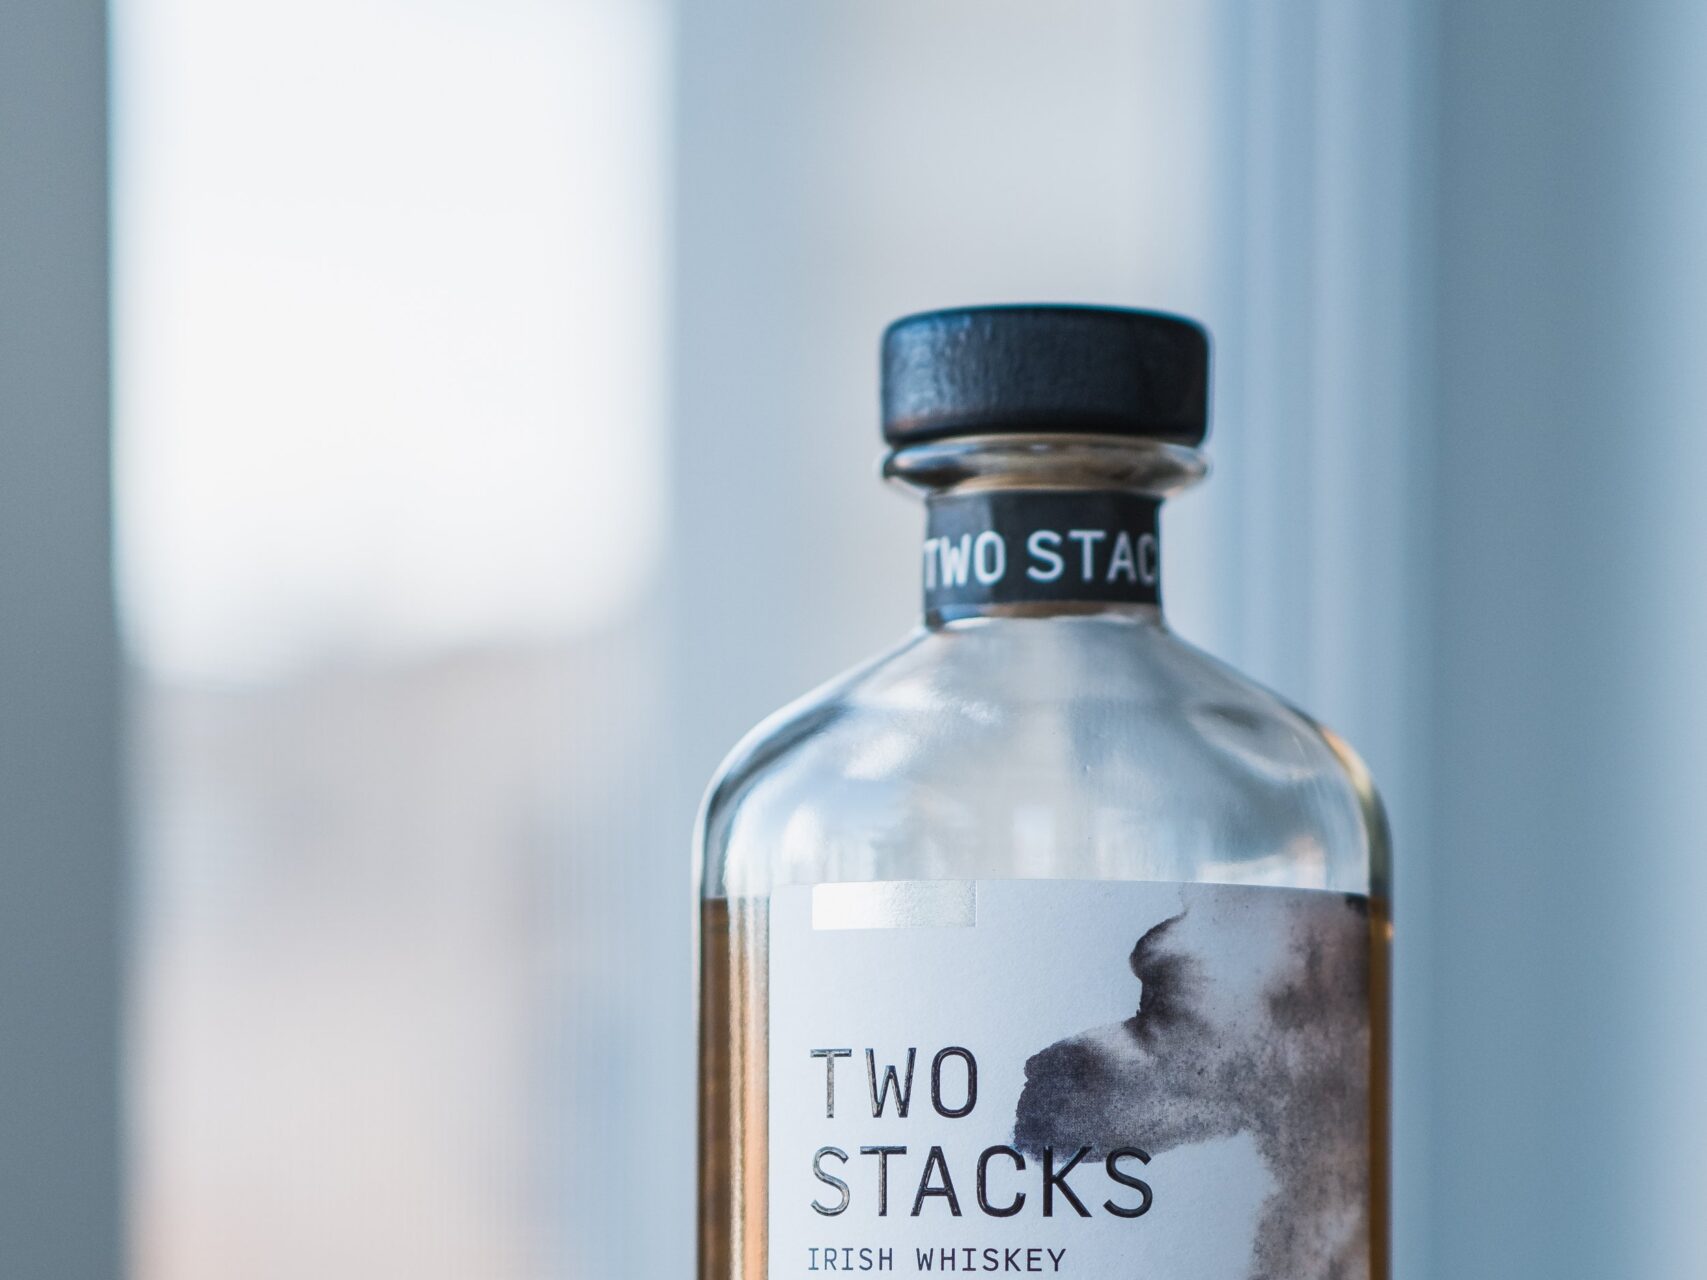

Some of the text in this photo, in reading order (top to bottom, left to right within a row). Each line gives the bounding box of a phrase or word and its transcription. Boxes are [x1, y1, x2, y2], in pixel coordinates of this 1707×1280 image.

[924, 530, 1005, 589] TWO
[809, 1046, 979, 1120] TWO
[809, 1144, 1154, 1219] STACKS
[808, 1248, 1067, 1272] IRISH WHISKEY
